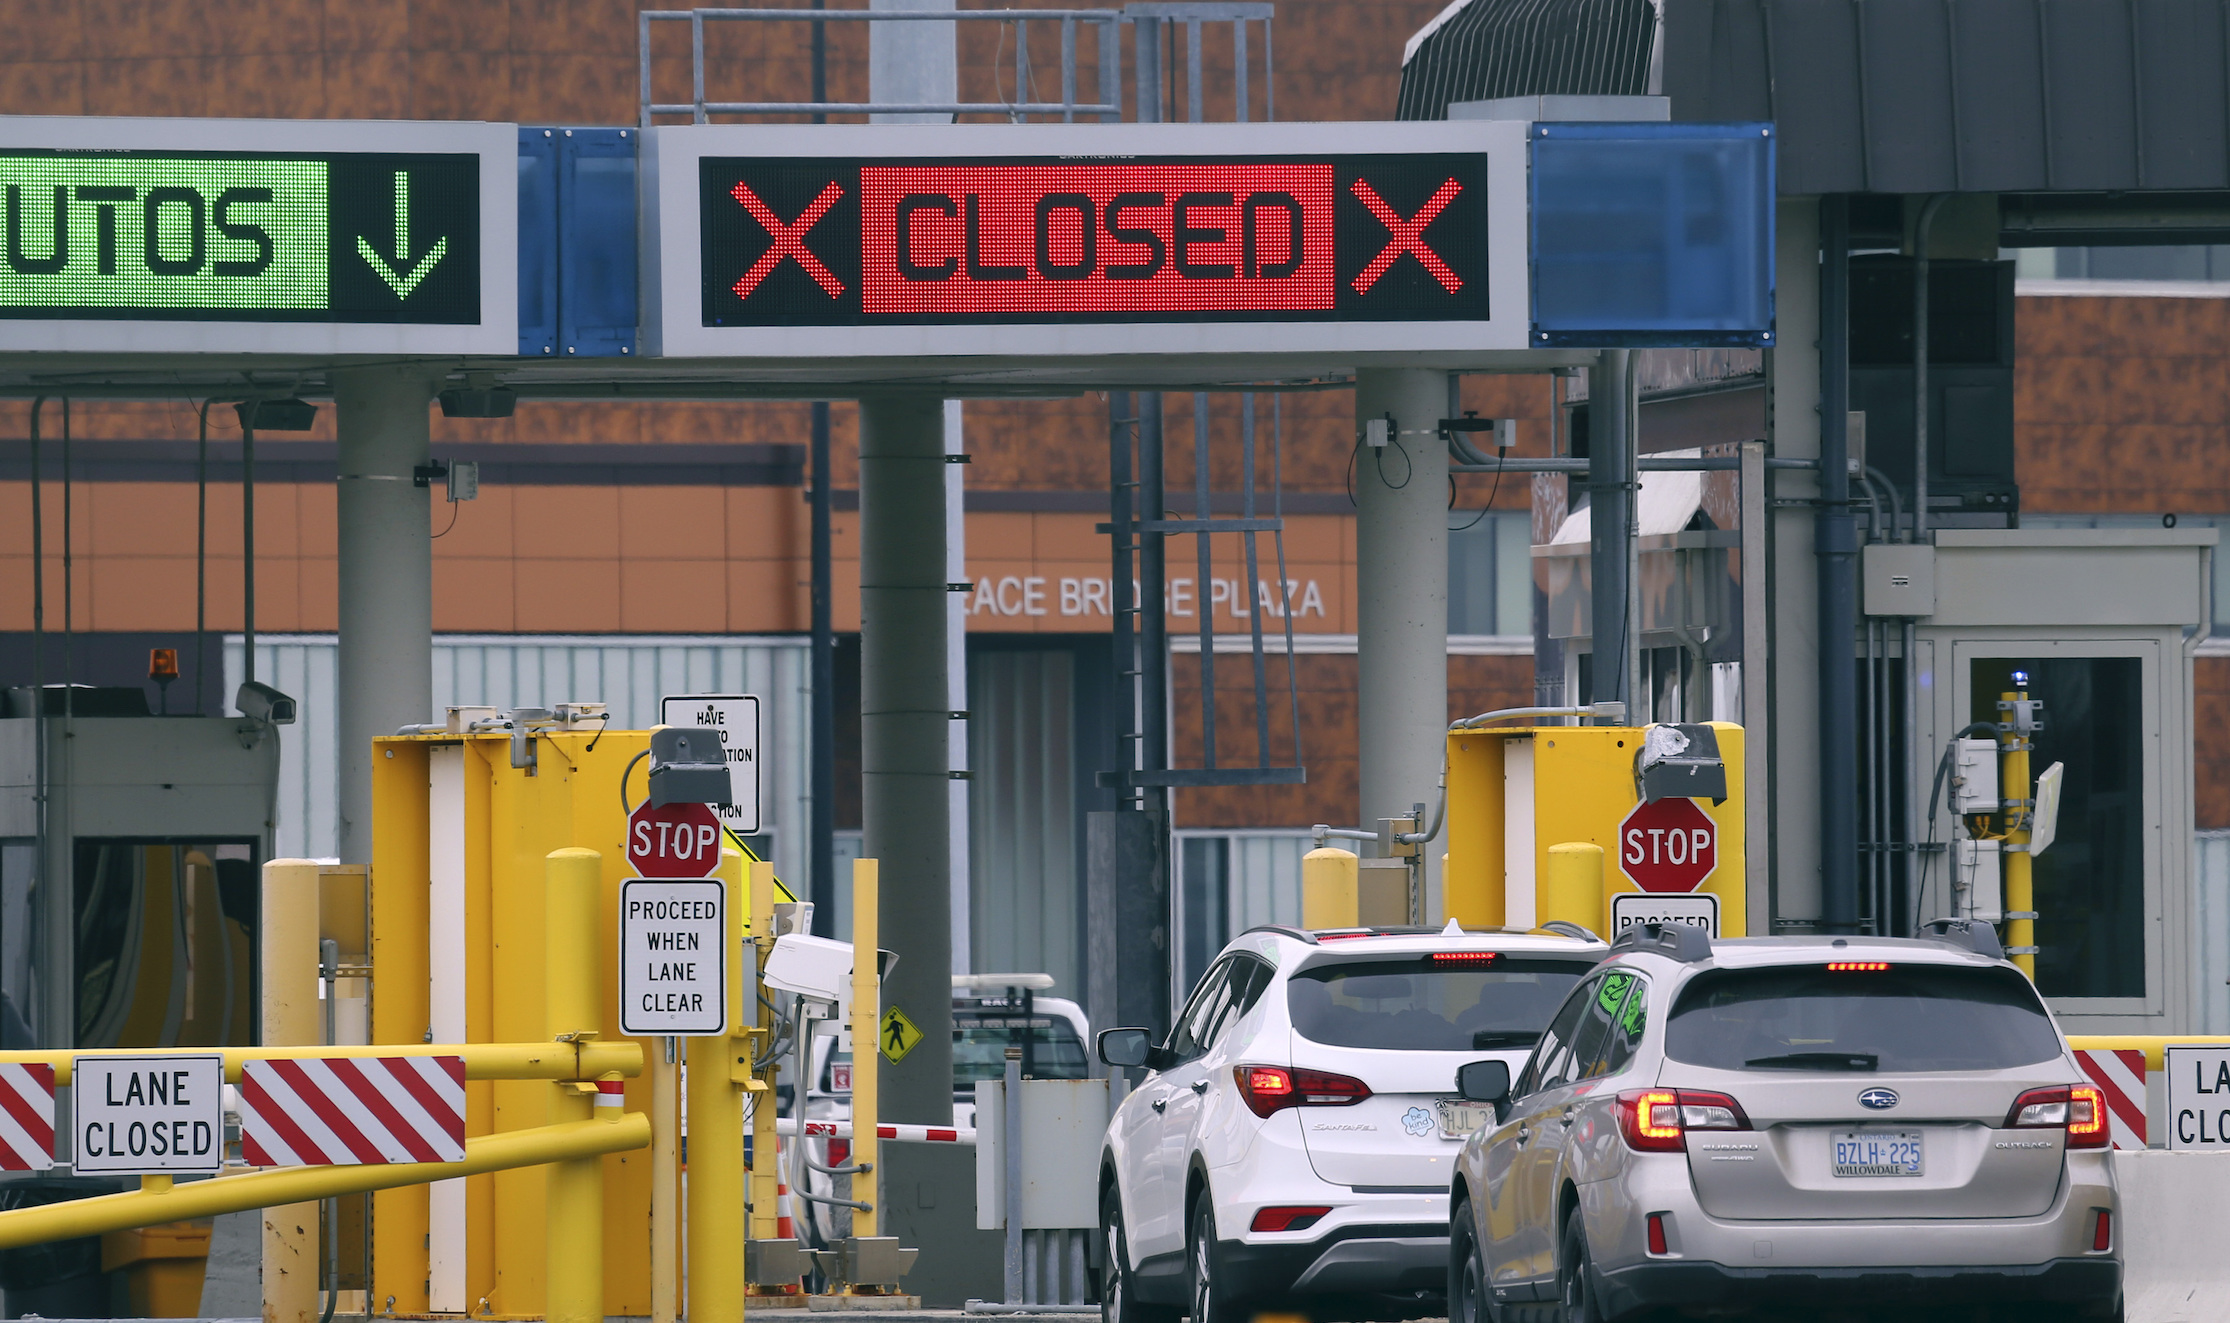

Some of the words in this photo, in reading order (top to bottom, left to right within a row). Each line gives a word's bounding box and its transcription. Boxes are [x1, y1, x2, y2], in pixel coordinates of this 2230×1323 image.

[6, 185, 274, 276] UTOS
[897, 192, 1302, 281] CLOSED
[964, 576, 1048, 617] ACE
[1210, 577, 1326, 618] PLAZA
[697, 711, 725, 725] HAVE
[632, 820, 716, 861] STOP
[1625, 828, 1711, 865] STOP
[629, 901, 716, 920] PROCEED
[647, 932, 699, 951] WHEN
[649, 963, 696, 981] LANE
[642, 993, 703, 1012] CLEAR
[106, 1071, 190, 1106] LANE
[1408, 1118, 1429, 1130] kind
[86, 1121, 211, 1157] CLOSED
[1995, 1142, 2054, 1150] OUTBACK
[1837, 1142, 1878, 1164] BZLH
[1889, 1142, 1920, 1164] 225
[1836, 1165, 1901, 1175] WILLOWDALE
